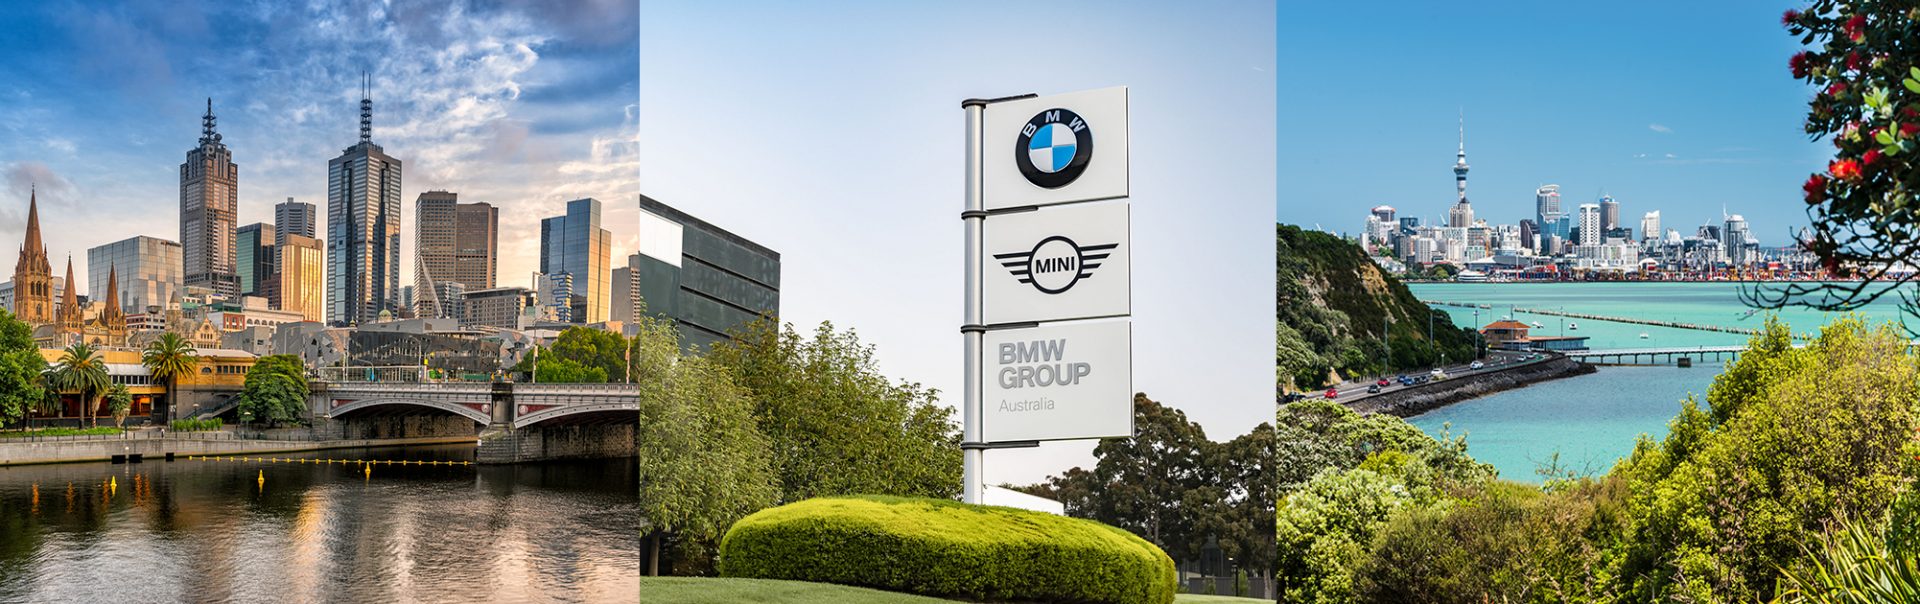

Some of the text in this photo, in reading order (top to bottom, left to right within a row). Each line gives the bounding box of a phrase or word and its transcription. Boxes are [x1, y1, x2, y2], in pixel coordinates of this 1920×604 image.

[1022, 110, 1086, 138] BMW
[1035, 256, 1075, 274] MINI
[998, 338, 1066, 365] BMW
[998, 362, 1091, 389] GROUP
[998, 397, 1055, 412] Australia
